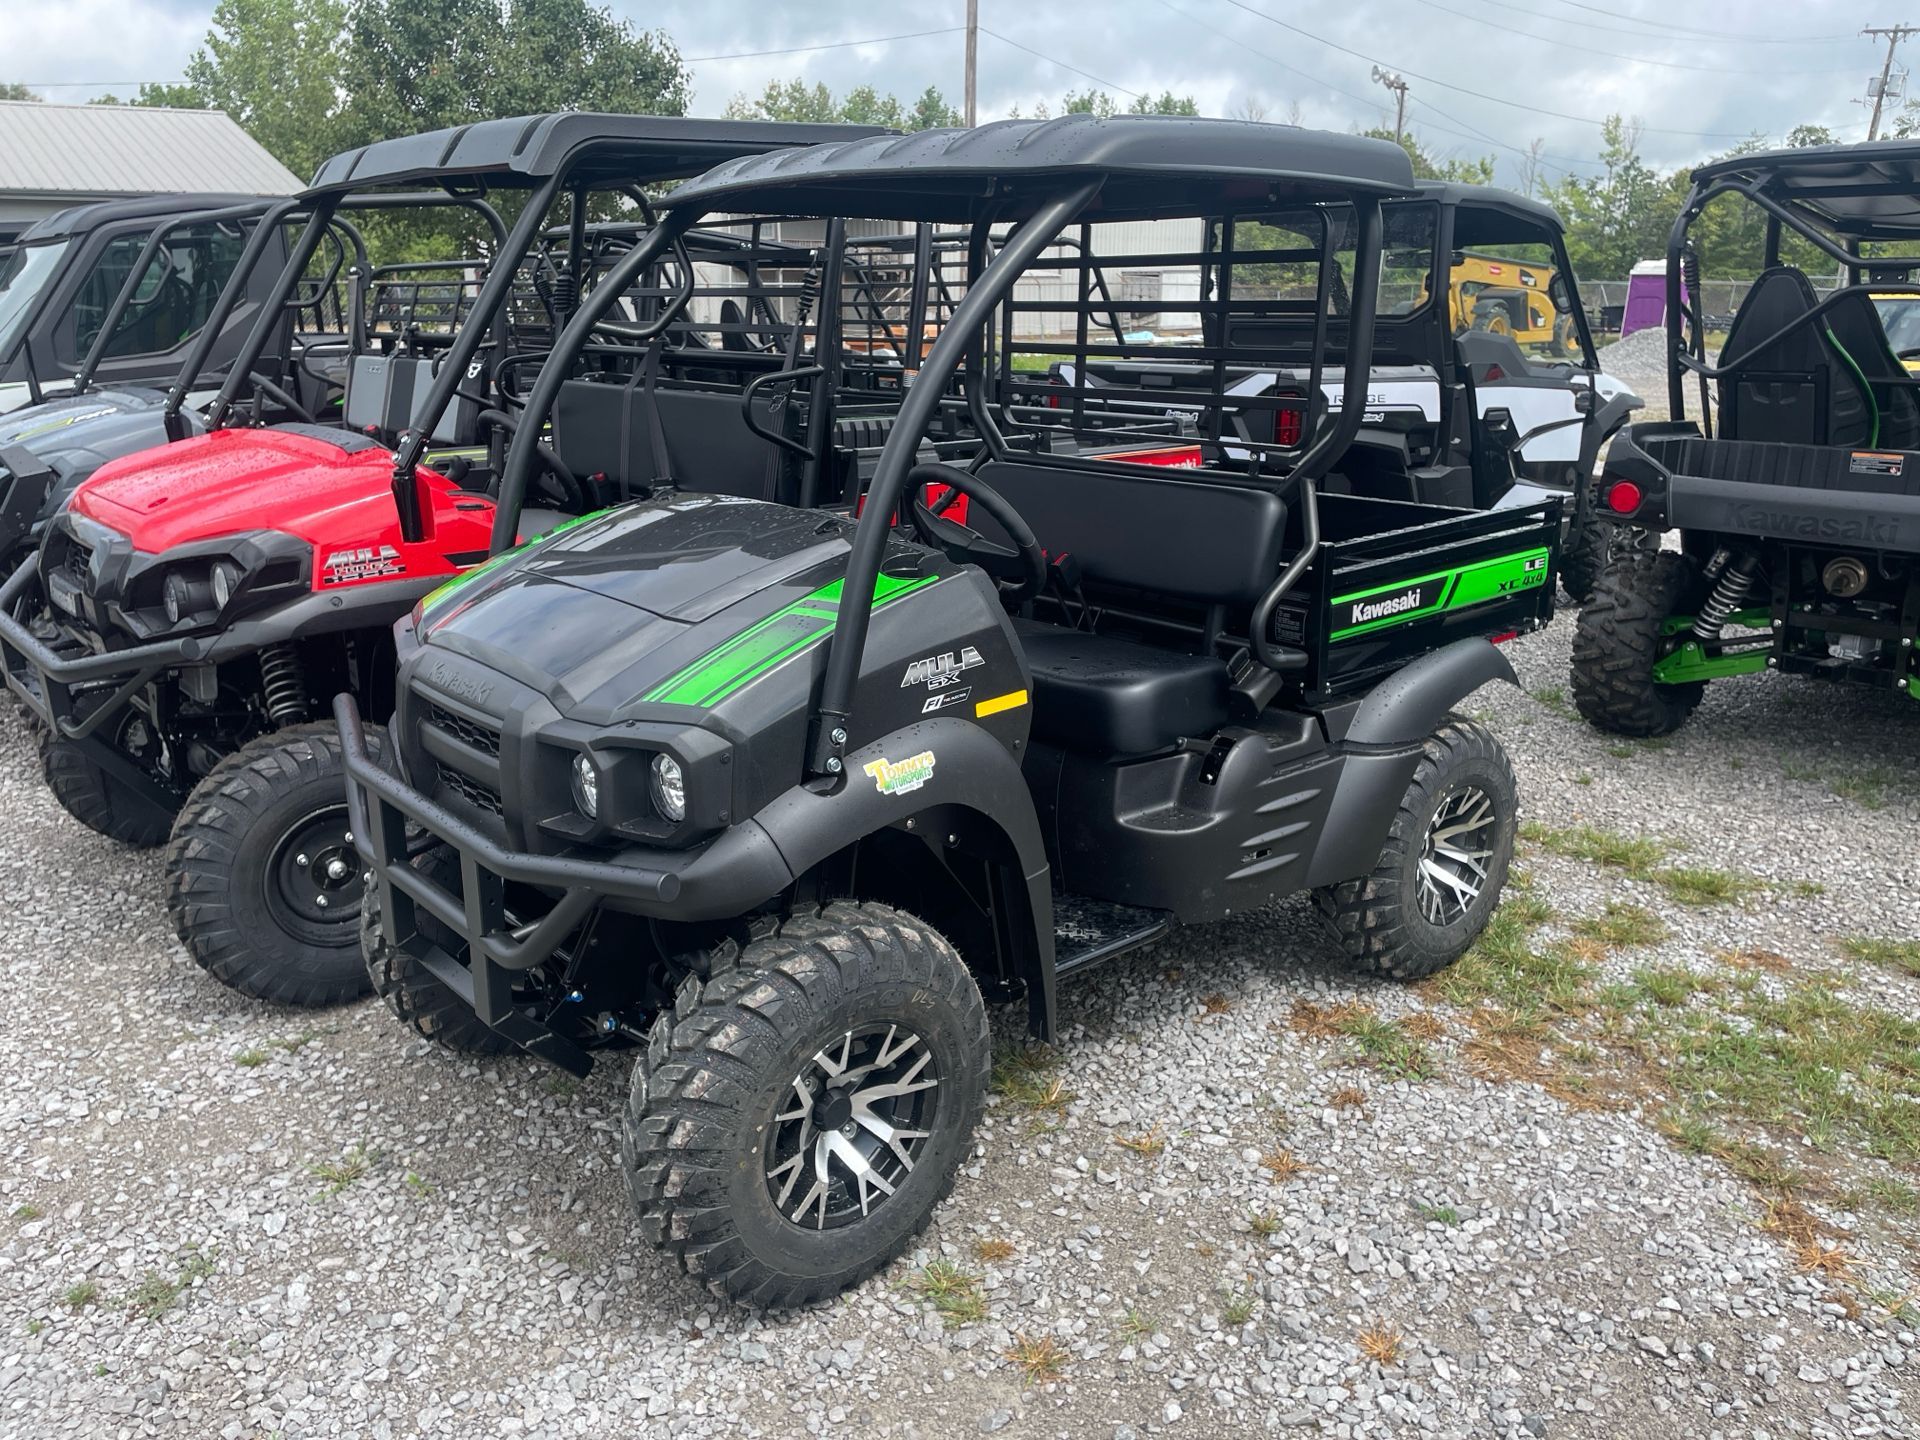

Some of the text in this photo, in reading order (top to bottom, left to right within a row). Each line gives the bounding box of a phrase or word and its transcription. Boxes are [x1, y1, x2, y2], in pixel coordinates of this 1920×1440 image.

[1333, 394, 1387, 404] RGE
[1726, 502, 1900, 545] Kawasaki
[323, 545, 401, 570] MULE
[1524, 558, 1546, 572] LE
[1498, 572, 1544, 593] XC 4x4
[1351, 588, 1421, 624] Kawasaki
[900, 646, 986, 688] MULE
[427, 659, 496, 705] Kawasaki
[927, 670, 961, 690] SX
